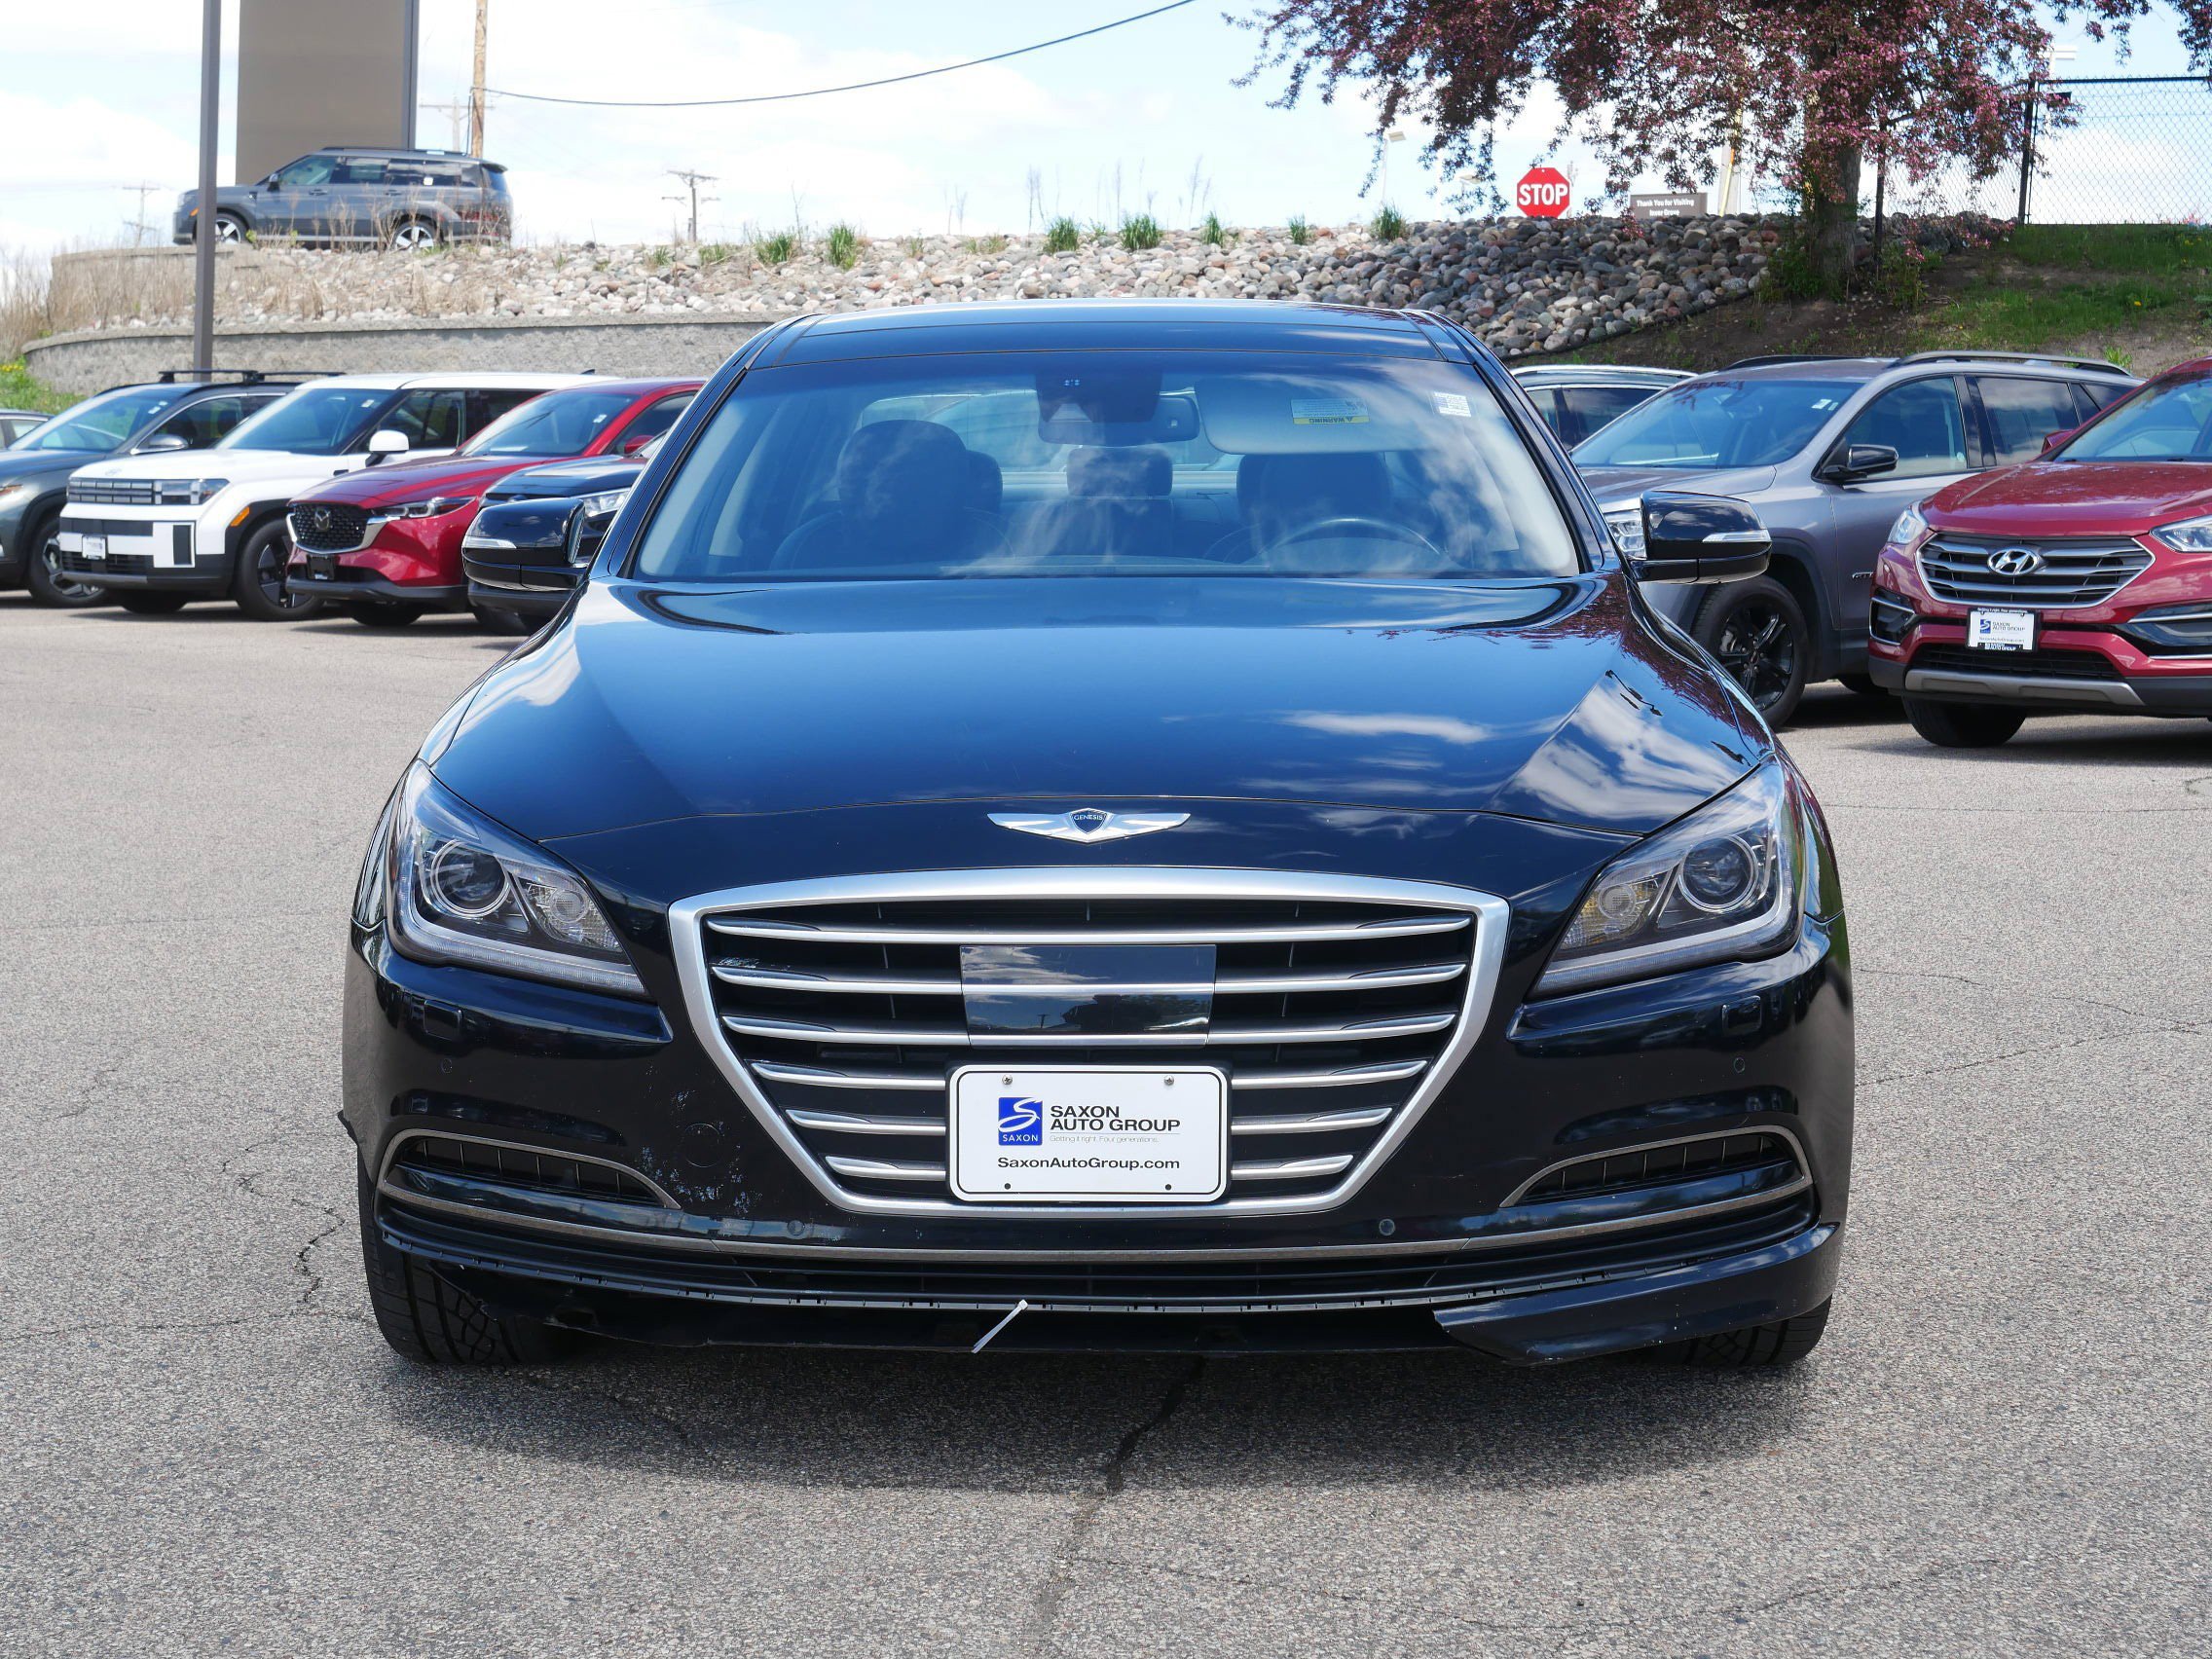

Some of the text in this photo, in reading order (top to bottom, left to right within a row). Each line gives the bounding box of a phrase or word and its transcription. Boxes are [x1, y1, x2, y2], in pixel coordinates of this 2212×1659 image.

[1519, 183, 1568, 205] STOP
[1673, 199, 1695, 207] Visiting
[1050, 1105, 1120, 1118] SAXON
[1050, 1119, 1181, 1131] AUTO GROUP
[1002, 1133, 1039, 1142] SAXON
[998, 1157, 1180, 1170] SaxonAutoGroup.com
